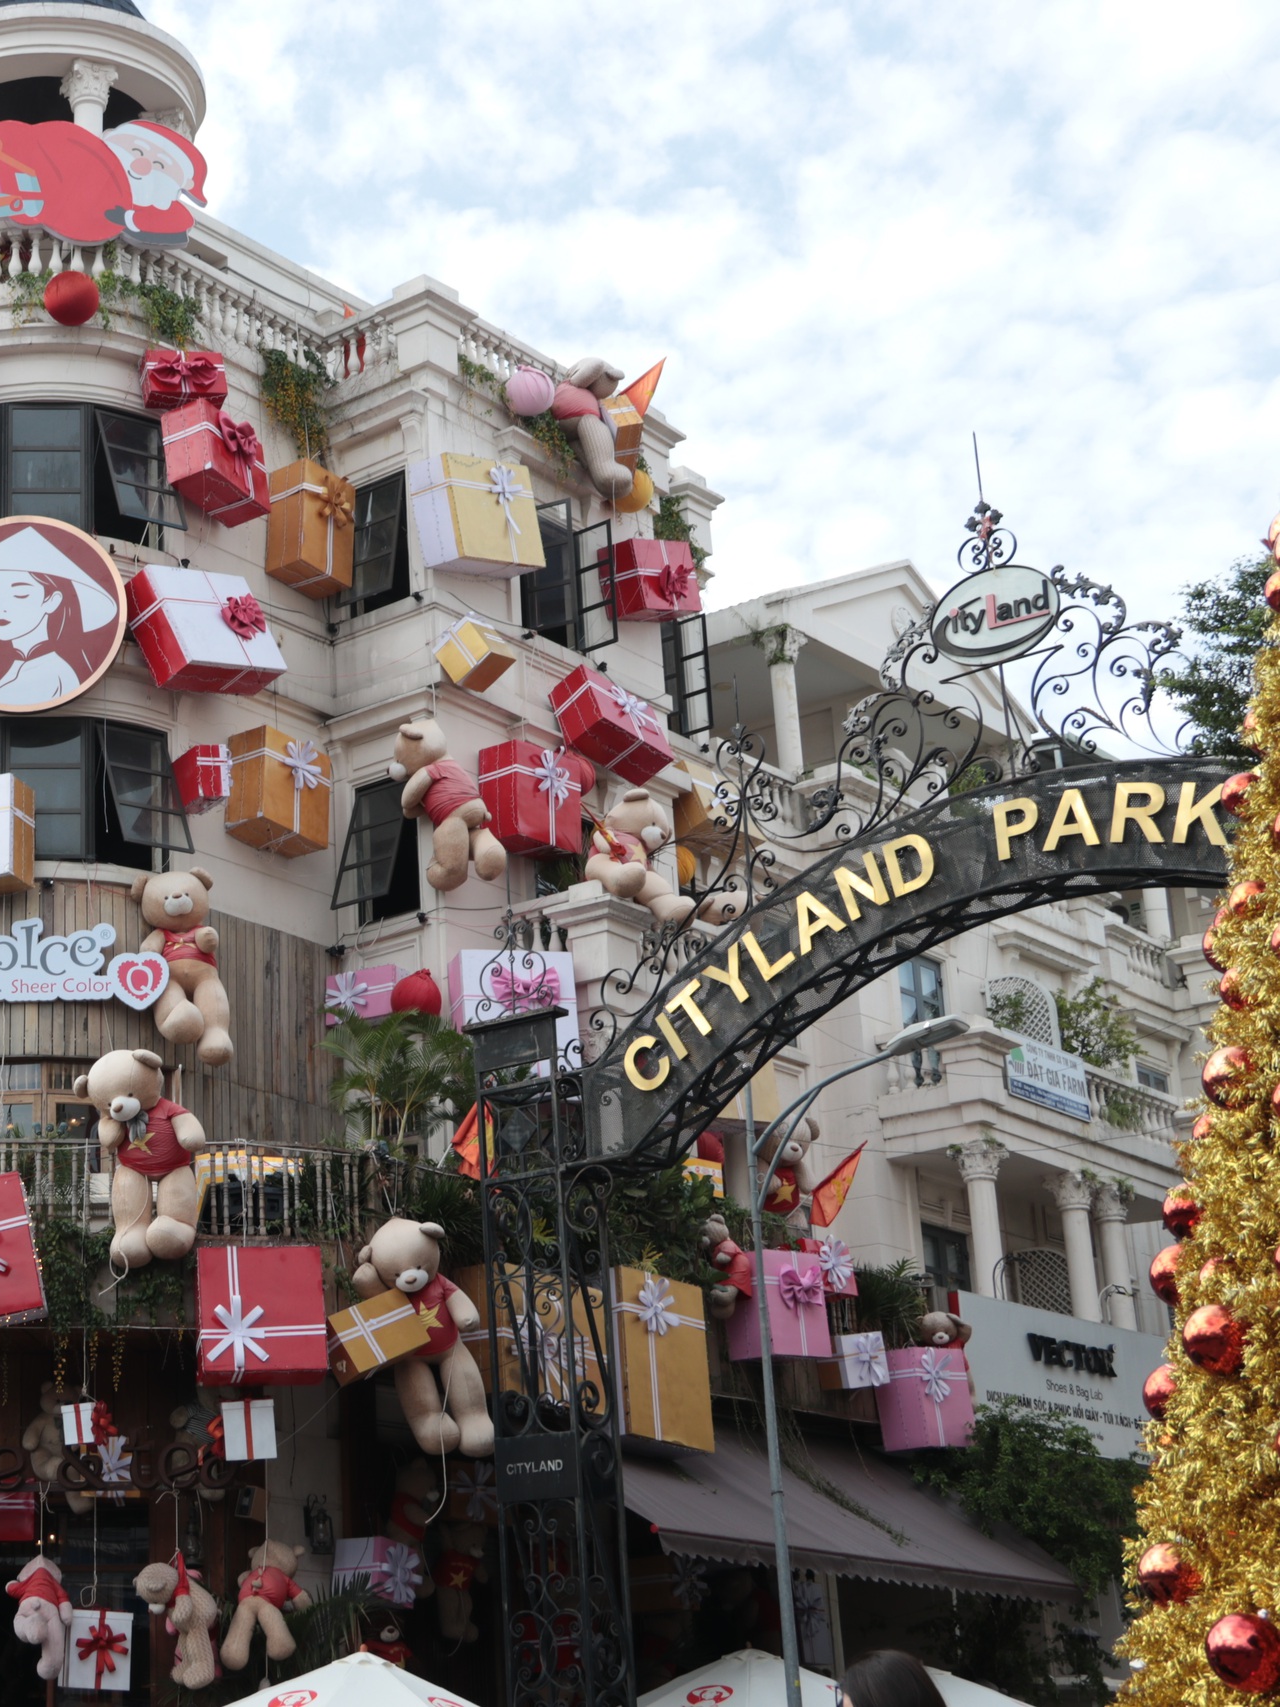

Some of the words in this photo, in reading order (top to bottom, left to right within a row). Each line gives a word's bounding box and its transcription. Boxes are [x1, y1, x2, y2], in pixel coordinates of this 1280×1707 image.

[623, 833, 935, 1092] CITYLAND
[992, 781, 1228, 862] PARK
[10, 977, 57, 995] Sheer
[62, 977, 112, 995] Color
[1027, 1057, 1044, 1082] ĐẤT
[1046, 1068, 1061, 1089] GIA
[1062, 1073, 1086, 1099] FARM
[1027, 1333, 1118, 1378] VECTOR
[1033, 1396, 1047, 1412] SÓC
[1046, 1379, 1068, 1394] Shoes
[1076, 1385, 1090, 1401] Bag
[1090, 1387, 1104, 1401] Lab
[57, 1438, 106, 1490] &
[506, 1459, 564, 1475] CITYLAND
